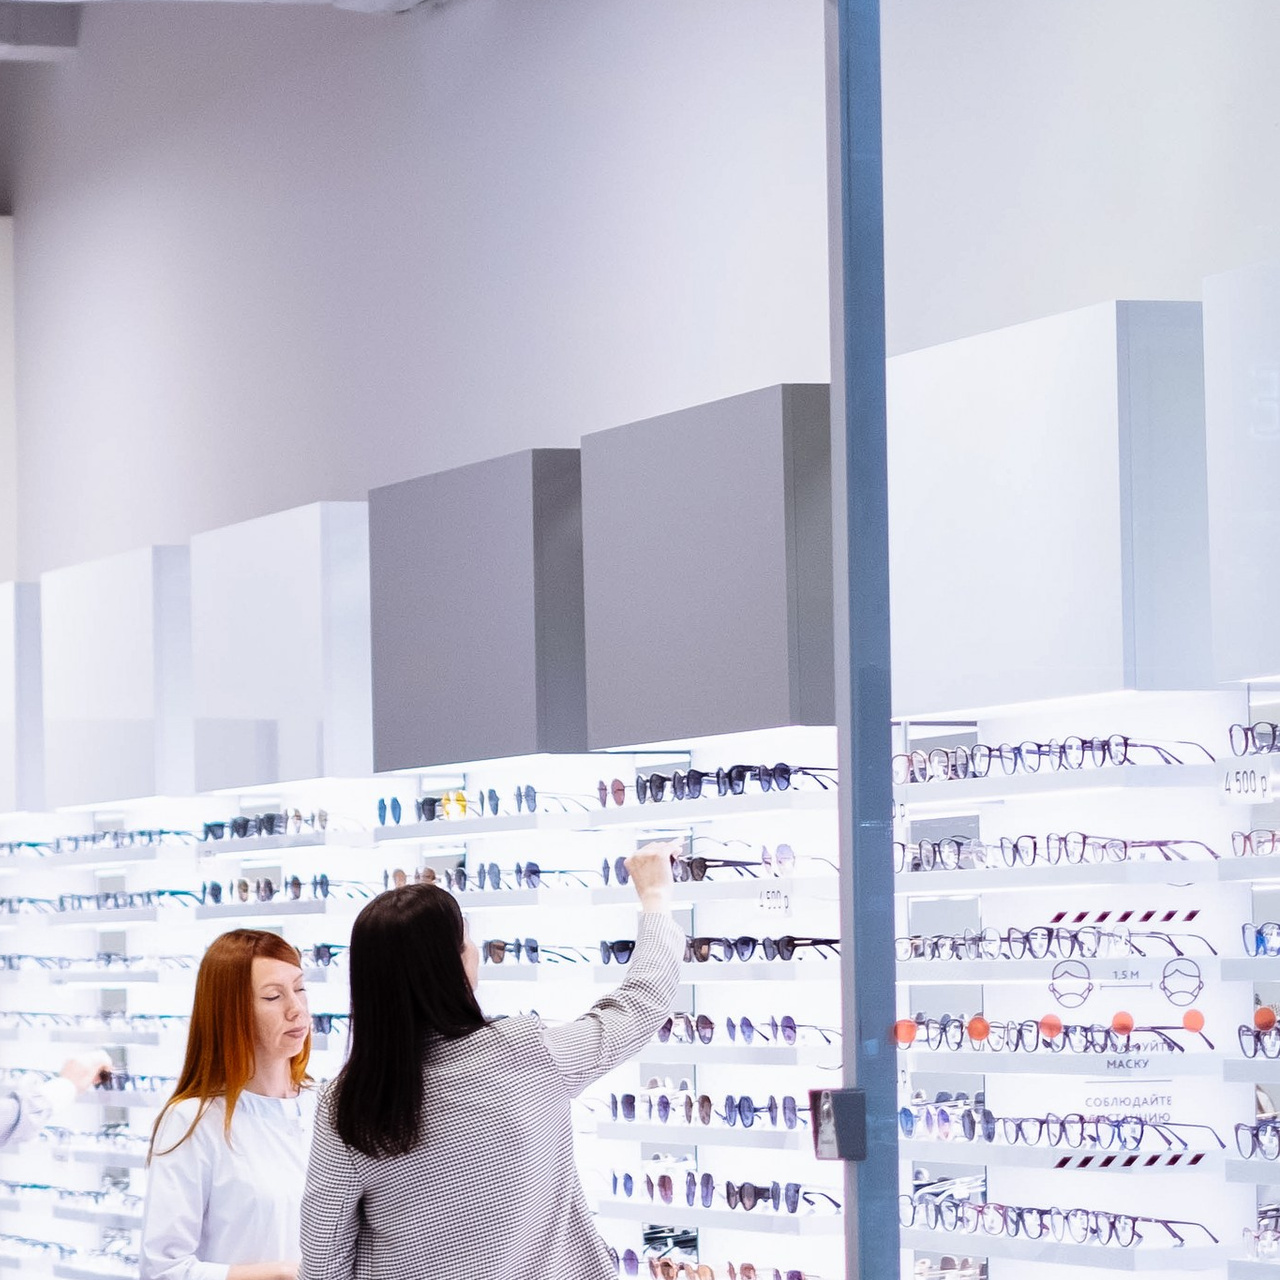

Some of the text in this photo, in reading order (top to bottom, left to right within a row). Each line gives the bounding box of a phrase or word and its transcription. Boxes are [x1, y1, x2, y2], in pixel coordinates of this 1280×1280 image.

[1225, 771, 1231, 793] 4
[1235, 770, 1257, 794] 500
[1106, 1058, 1150, 1070] МАСКУ
[1085, 1094, 1172, 1108] СОБЛЮДАЙТЕ
